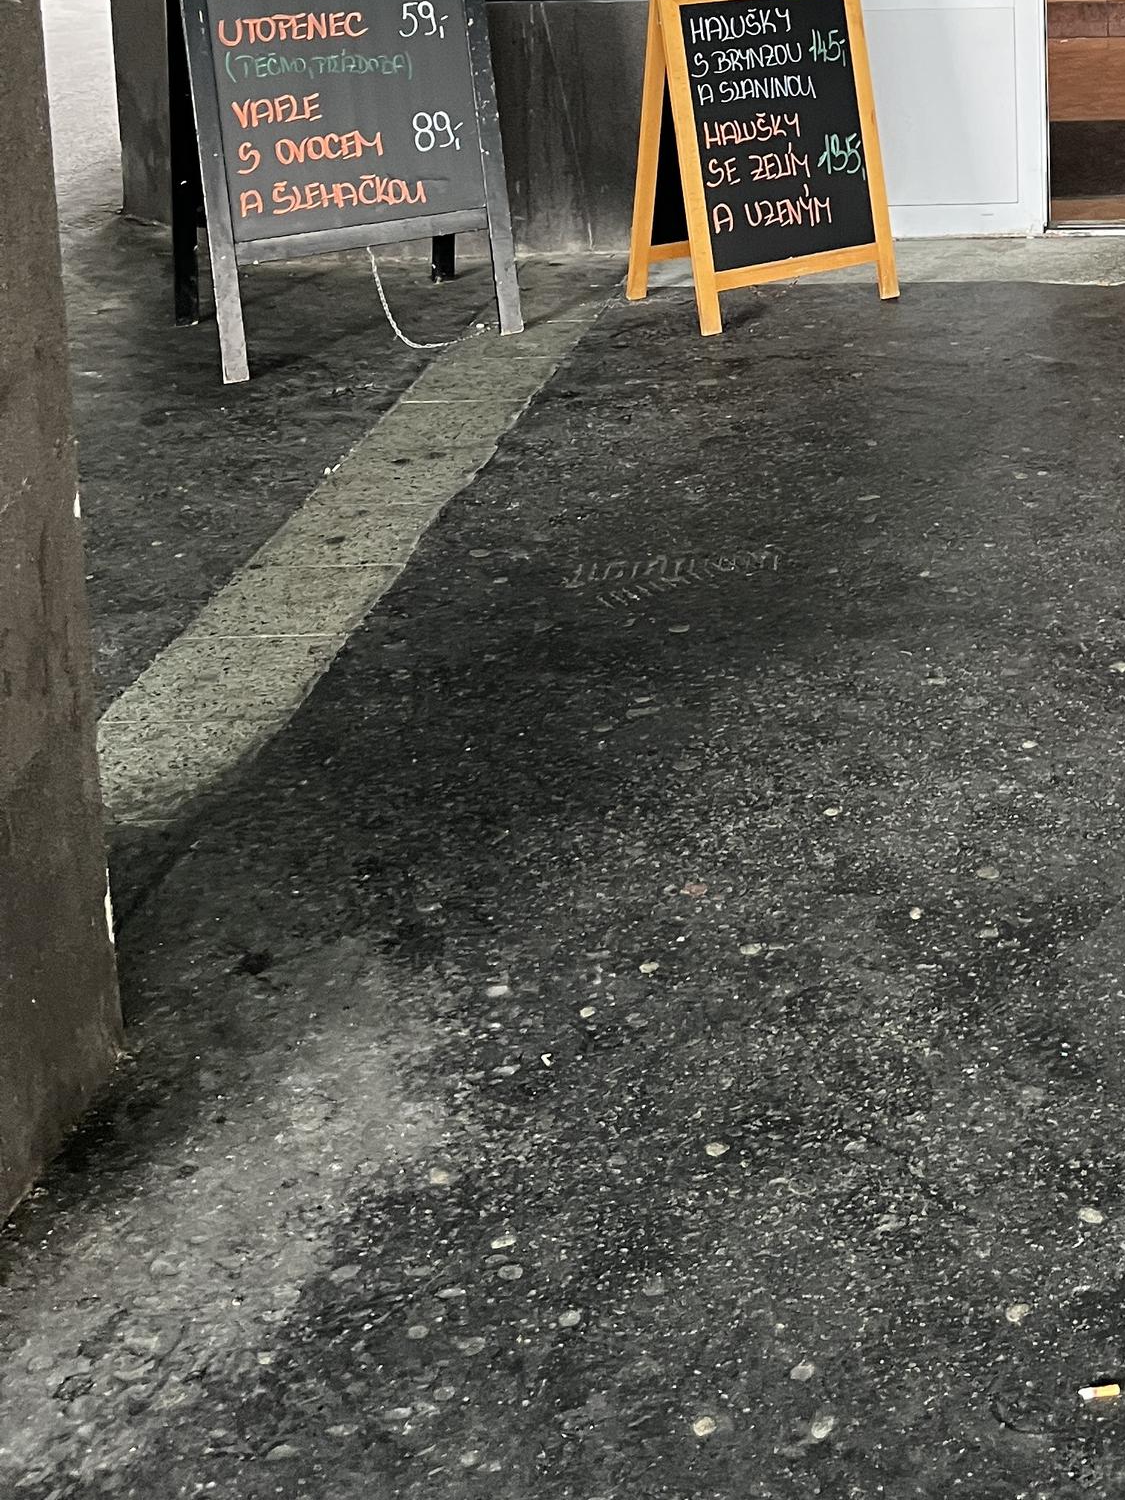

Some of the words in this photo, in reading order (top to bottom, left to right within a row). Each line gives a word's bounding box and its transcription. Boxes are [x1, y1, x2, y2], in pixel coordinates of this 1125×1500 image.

[217, 11, 369, 47] UTOPENEC
[690, 7, 791, 44] HALUŠKY
[691, 52, 709, 78] S
[710, 42, 802, 74] BRYNZOU
[698, 83, 714, 106] A
[718, 75, 816, 102] SLANINOU
[231, 92, 323, 129] VAFLE
[704, 112, 801, 149] HALUŠKY
[237, 141, 260, 175] S
[274, 130, 384, 165] OVOCEM
[706, 157, 740, 188] SE
[749, 142, 811, 181] ZELÍM
[239, 189, 263, 217] A
[272, 174, 428, 215] ŠLEHAČKOU
[712, 203, 733, 234] A
[744, 184, 832, 227] UZENÝM
